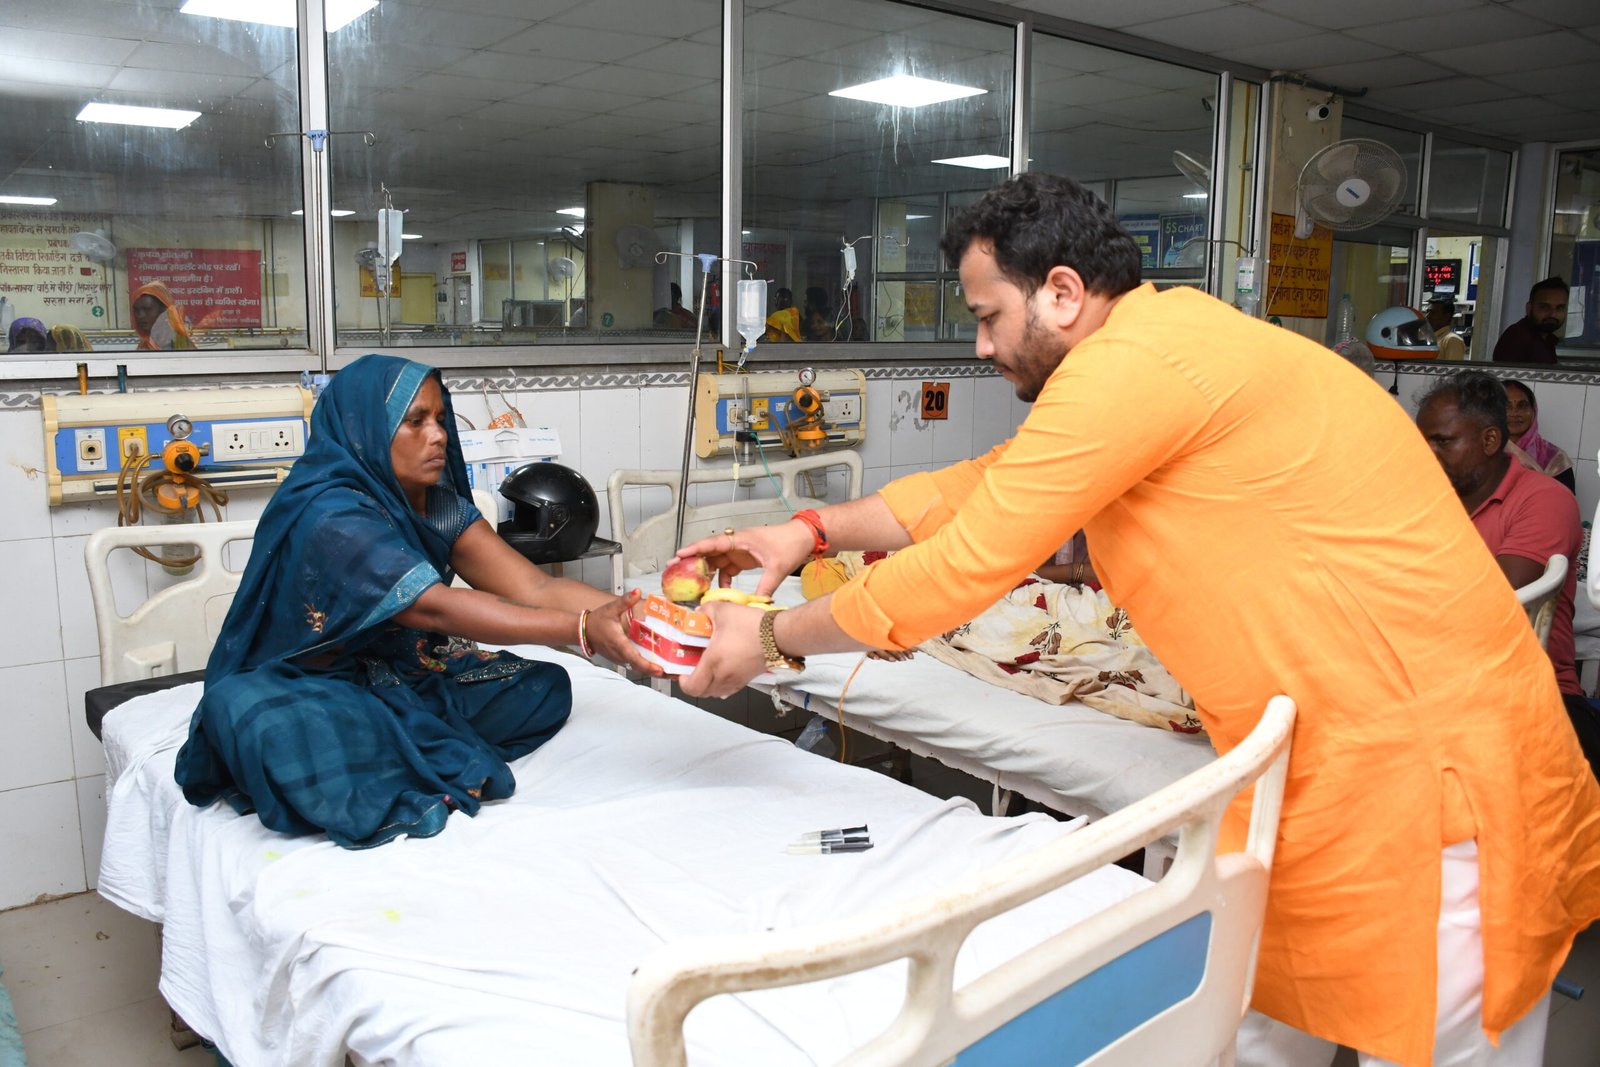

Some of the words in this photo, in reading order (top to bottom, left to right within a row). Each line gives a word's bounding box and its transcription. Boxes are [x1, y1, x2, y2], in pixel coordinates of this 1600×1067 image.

[1165, 221, 1177, 234] 5S
[1178, 223, 1203, 233] CHART
[924, 390, 945, 411] 20
